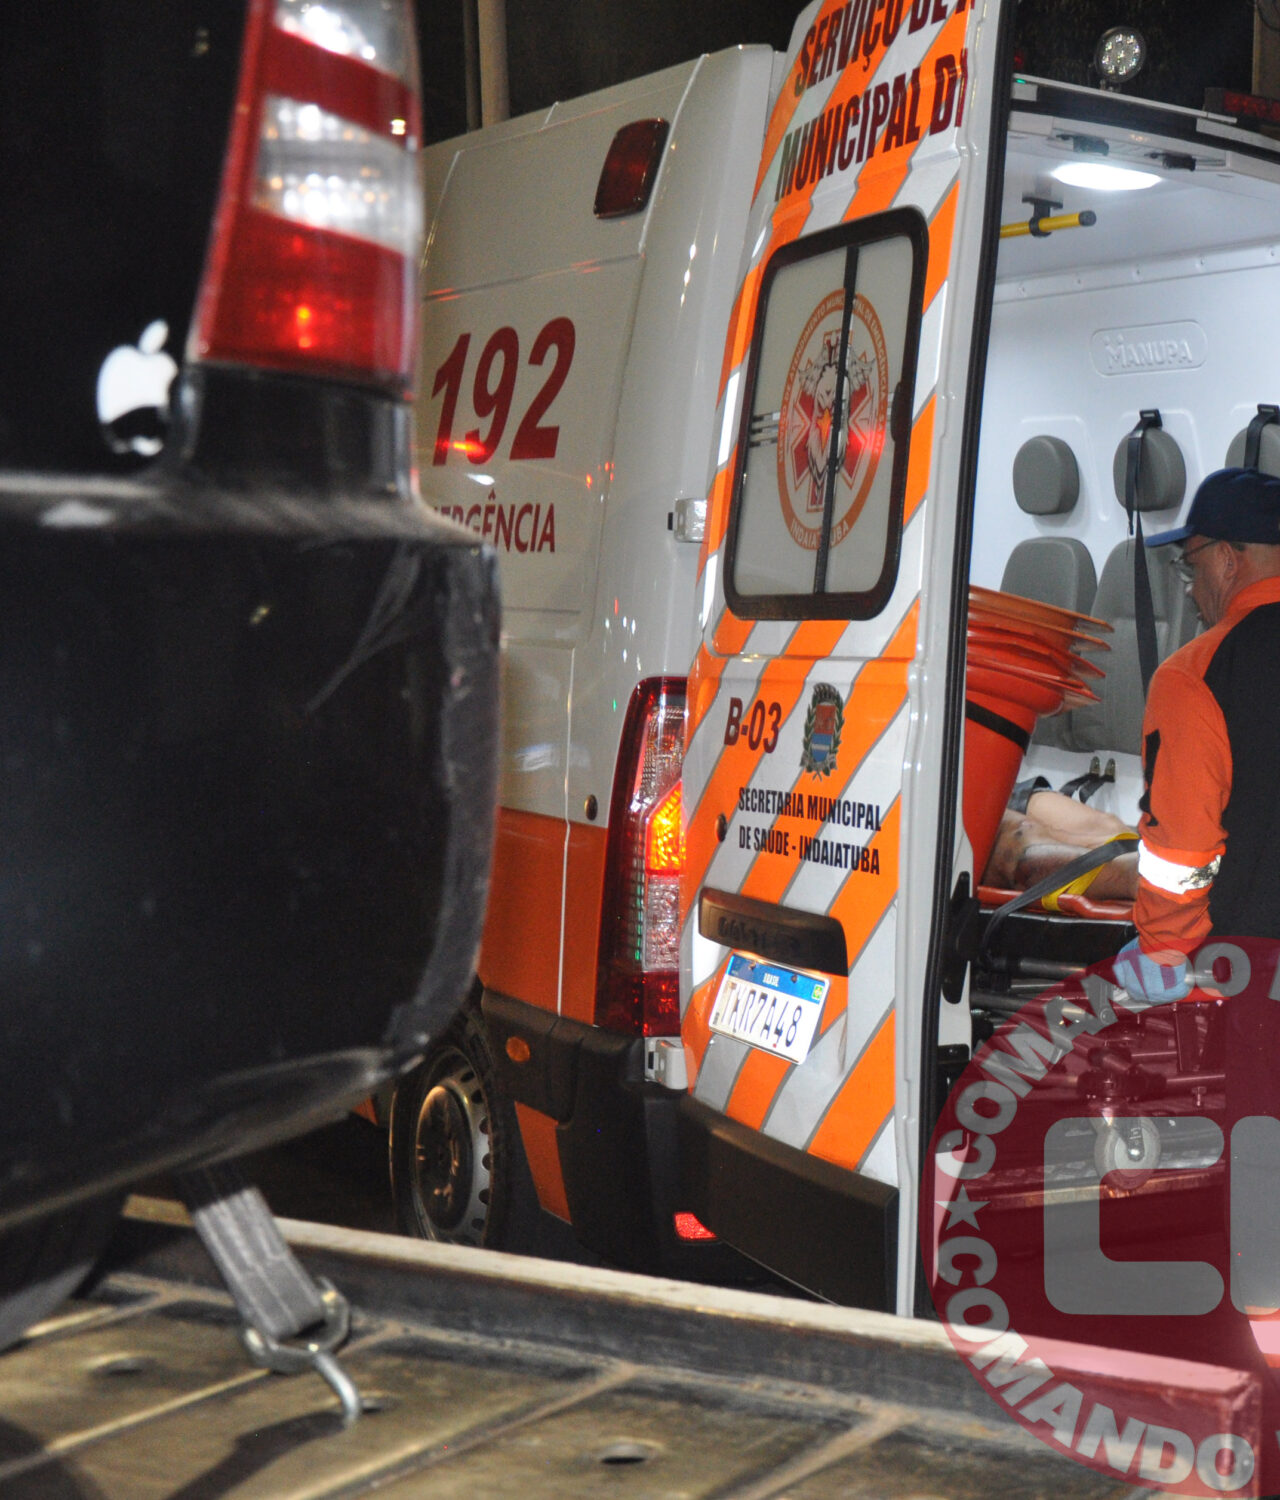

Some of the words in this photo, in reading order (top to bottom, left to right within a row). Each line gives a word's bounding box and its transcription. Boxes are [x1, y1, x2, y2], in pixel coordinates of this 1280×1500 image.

[795, 0, 905, 97] SERVIÇO
[775, 65, 922, 202] MUNICIPAL
[1102, 334, 1193, 369] MANUPA
[431, 316, 576, 467] 192
[433, 488, 556, 553] GÊNCIA
[791, 517, 849, 548] INDAIAUBA
[723, 697, 782, 754] B-03
[738, 786, 804, 818] SECRETARIA
[806, 794, 882, 832] MUNICIPAL
[739, 825, 752, 850] DE
[799, 835, 880, 876] INDAIATUBA
